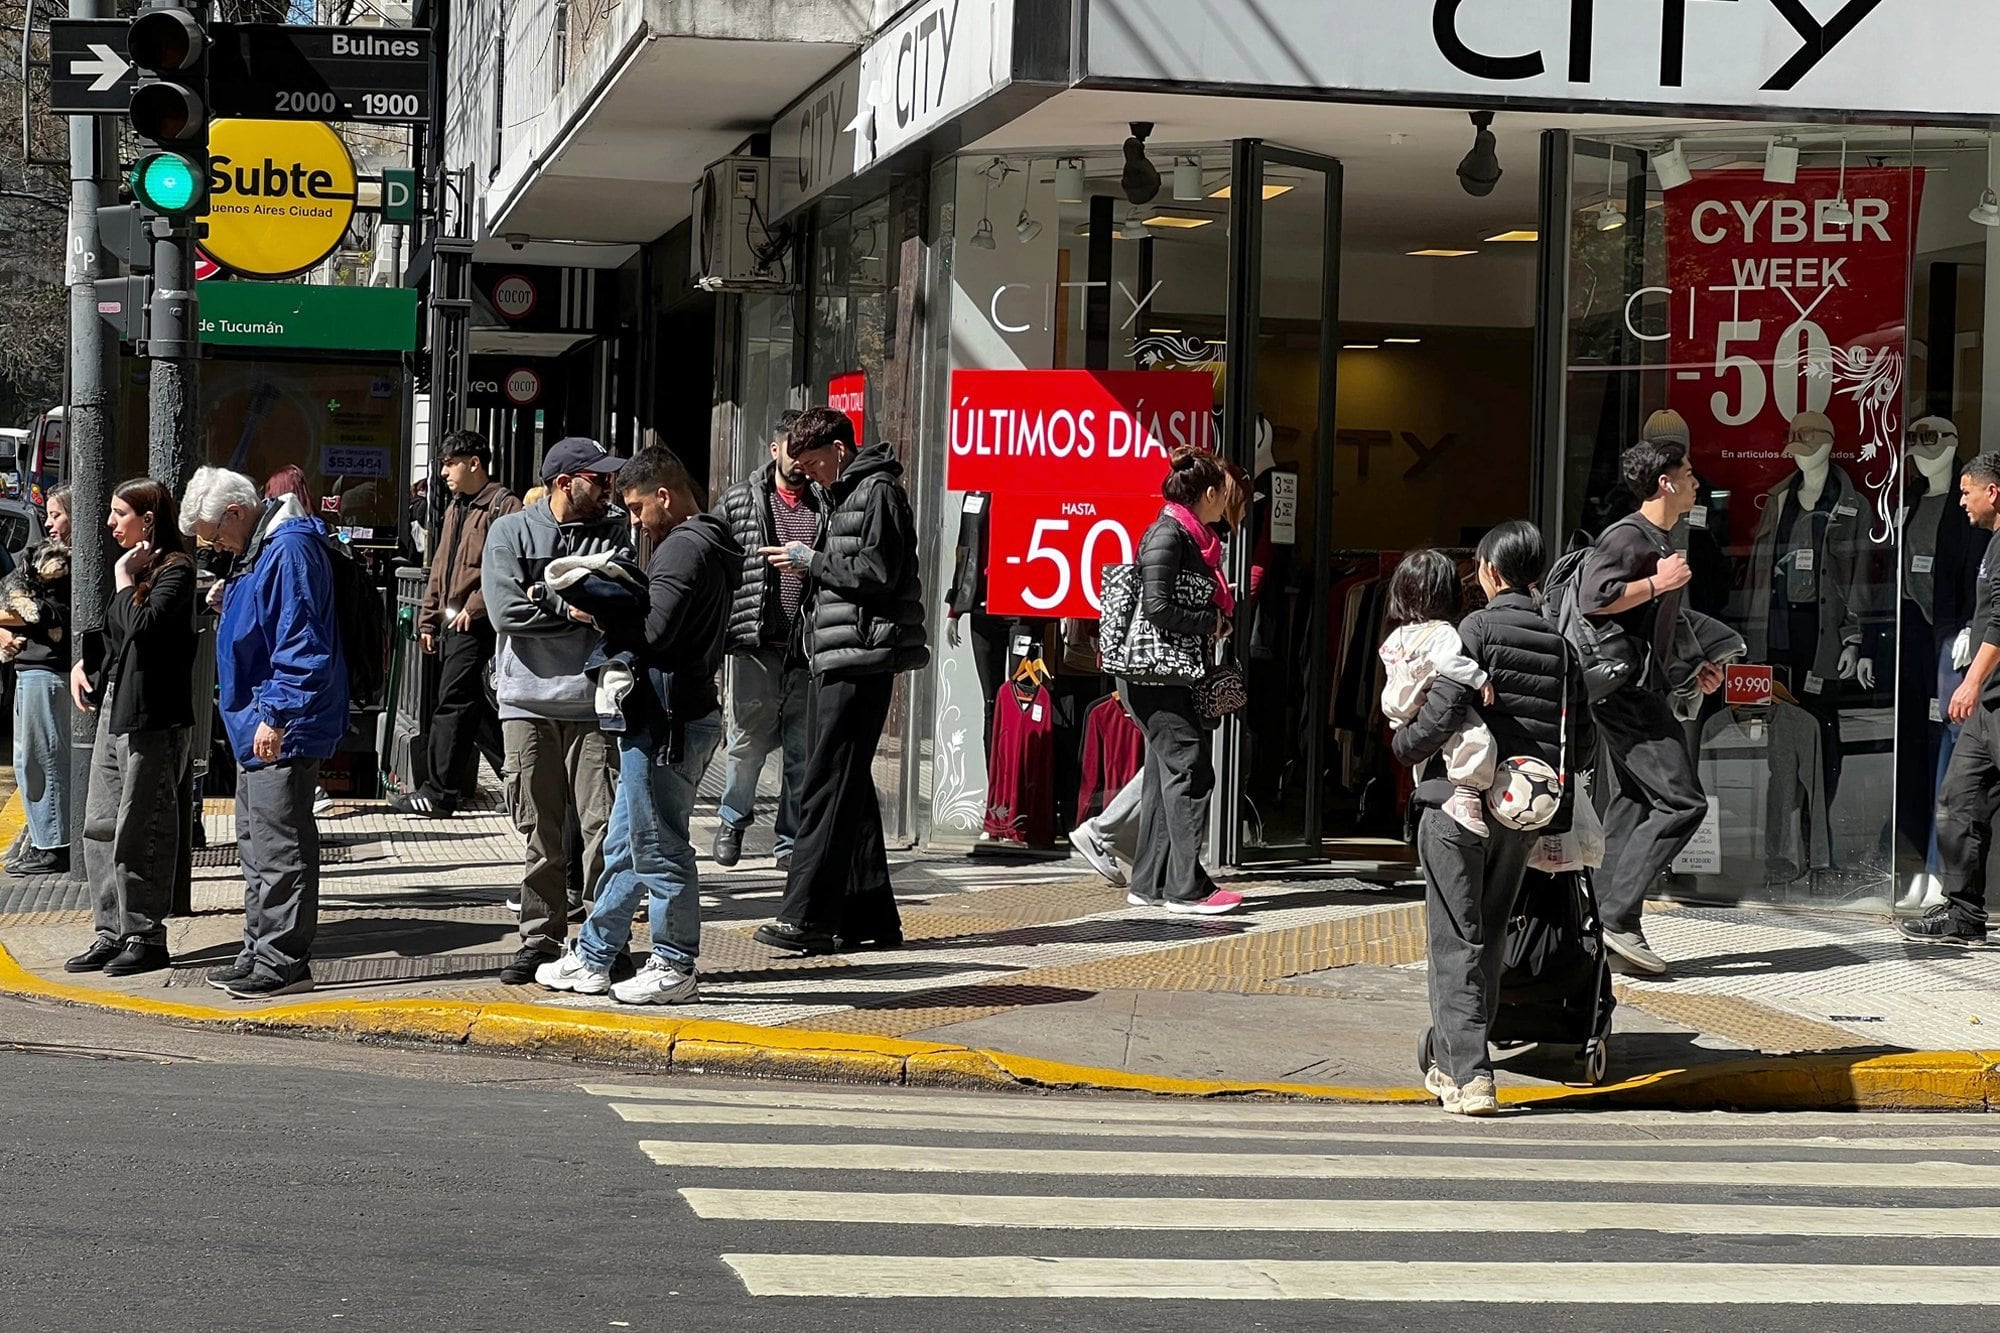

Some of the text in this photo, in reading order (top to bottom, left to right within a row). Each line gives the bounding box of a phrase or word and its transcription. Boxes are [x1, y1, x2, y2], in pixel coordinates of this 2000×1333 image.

[331, 34, 420, 57] Bulnes
[1433, 0, 1882, 90] CITY
[896, 0, 959, 129] CITY
[275, 91, 336, 113] 2000
[361, 94, 419, 116] 1900
[799, 80, 845, 193] CITY
[209, 155, 340, 199] Subte
[387, 181, 409, 207] D
[210, 204, 333, 218] uenos Aires Ciudad
[1690, 198, 1892, 244] CYBER
[1732, 257, 1848, 287] WEEK
[498, 289, 531, 304] COCOT
[990, 280, 1162, 332] CITY
[1625, 284, 1835, 341] CITY
[198, 318, 284, 334] de Tucumán
[509, 380, 536, 392] COCOT
[951, 396, 1095, 458] ÚLTIMOS
[1721, 449, 1735, 459] En
[1275, 476, 1282, 495] 3
[1061, 502, 1097, 516] HASTA
[1274, 500, 1282, 519] 6
[1006, 519, 1133, 610] -50
[1734, 676, 1771, 693] 9.990
